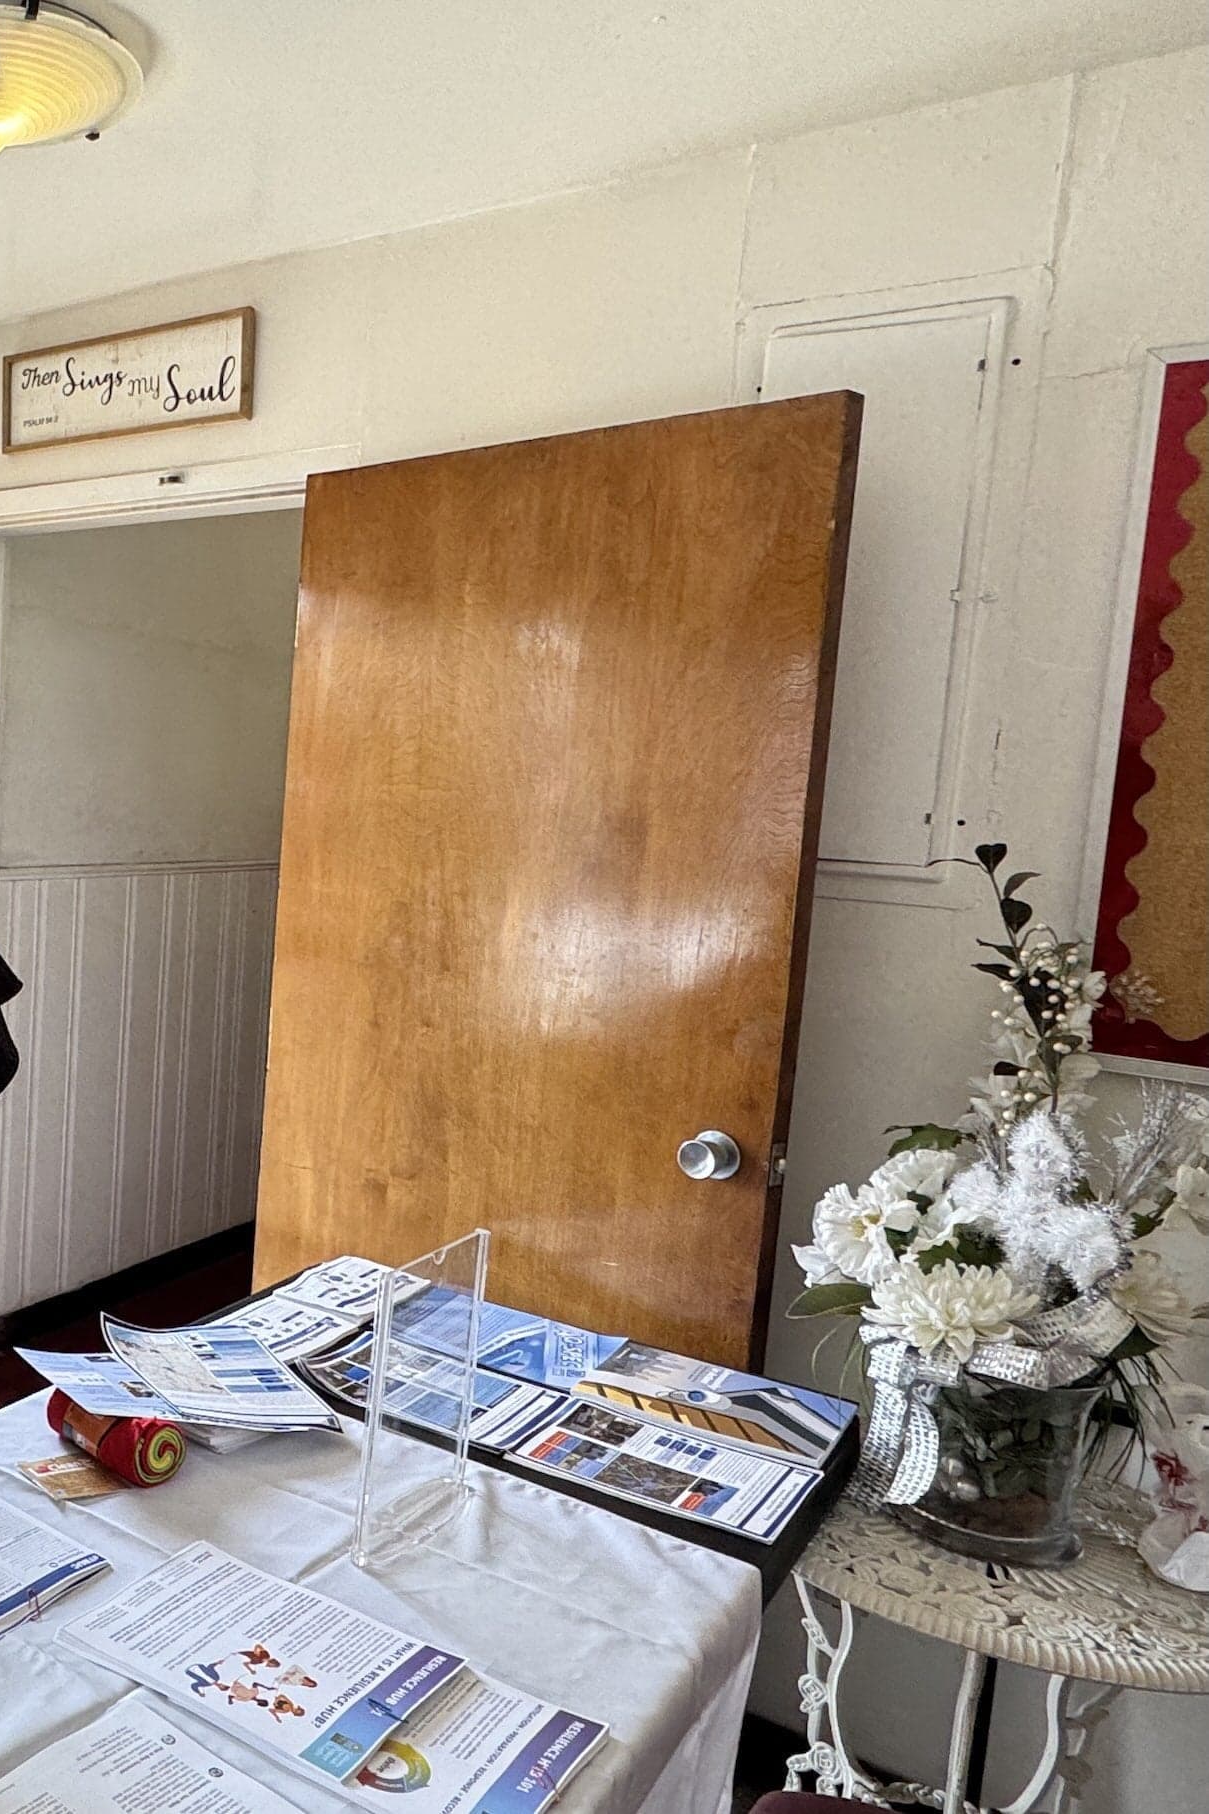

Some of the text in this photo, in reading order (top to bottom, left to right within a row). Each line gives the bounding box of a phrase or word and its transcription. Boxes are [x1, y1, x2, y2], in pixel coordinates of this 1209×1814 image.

[21, 355, 236, 412] Then Sings my Soul
[390, 1642, 417, 1660] WHAT
[404, 1655, 448, 1690] RESILIENCE
[339, 1671, 380, 1708] RESILIENCE
[385, 1687, 407, 1706] HUB
[314, 1704, 338, 1729] HUB?
[549, 1720, 586, 1760] RESILIENCE
[460, 1765, 487, 1795] RESPONSE
[516, 1776, 539, 1794] 101
